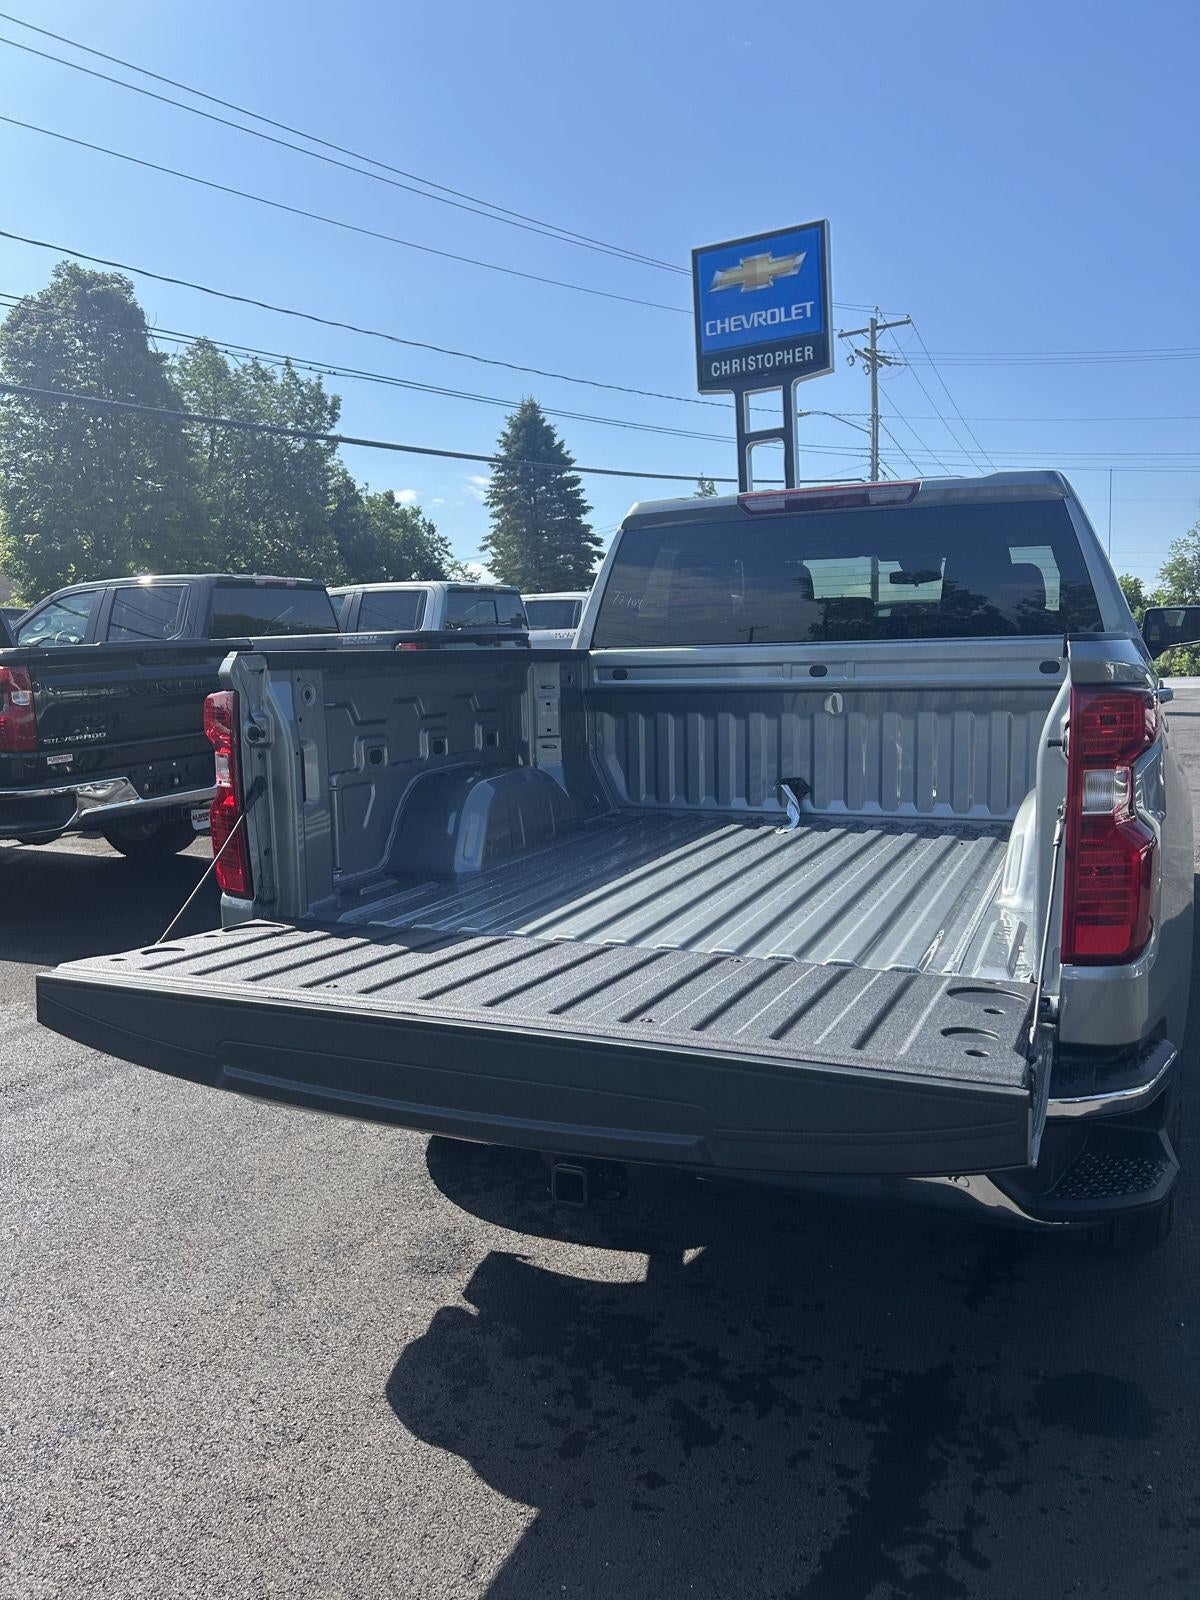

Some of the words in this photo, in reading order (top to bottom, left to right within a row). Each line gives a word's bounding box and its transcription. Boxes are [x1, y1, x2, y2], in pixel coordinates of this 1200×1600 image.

[705, 301, 815, 337] CHEVROLET
[711, 346, 814, 377] CHRISTOPHER
[43, 732, 107, 744] SILVERADO
